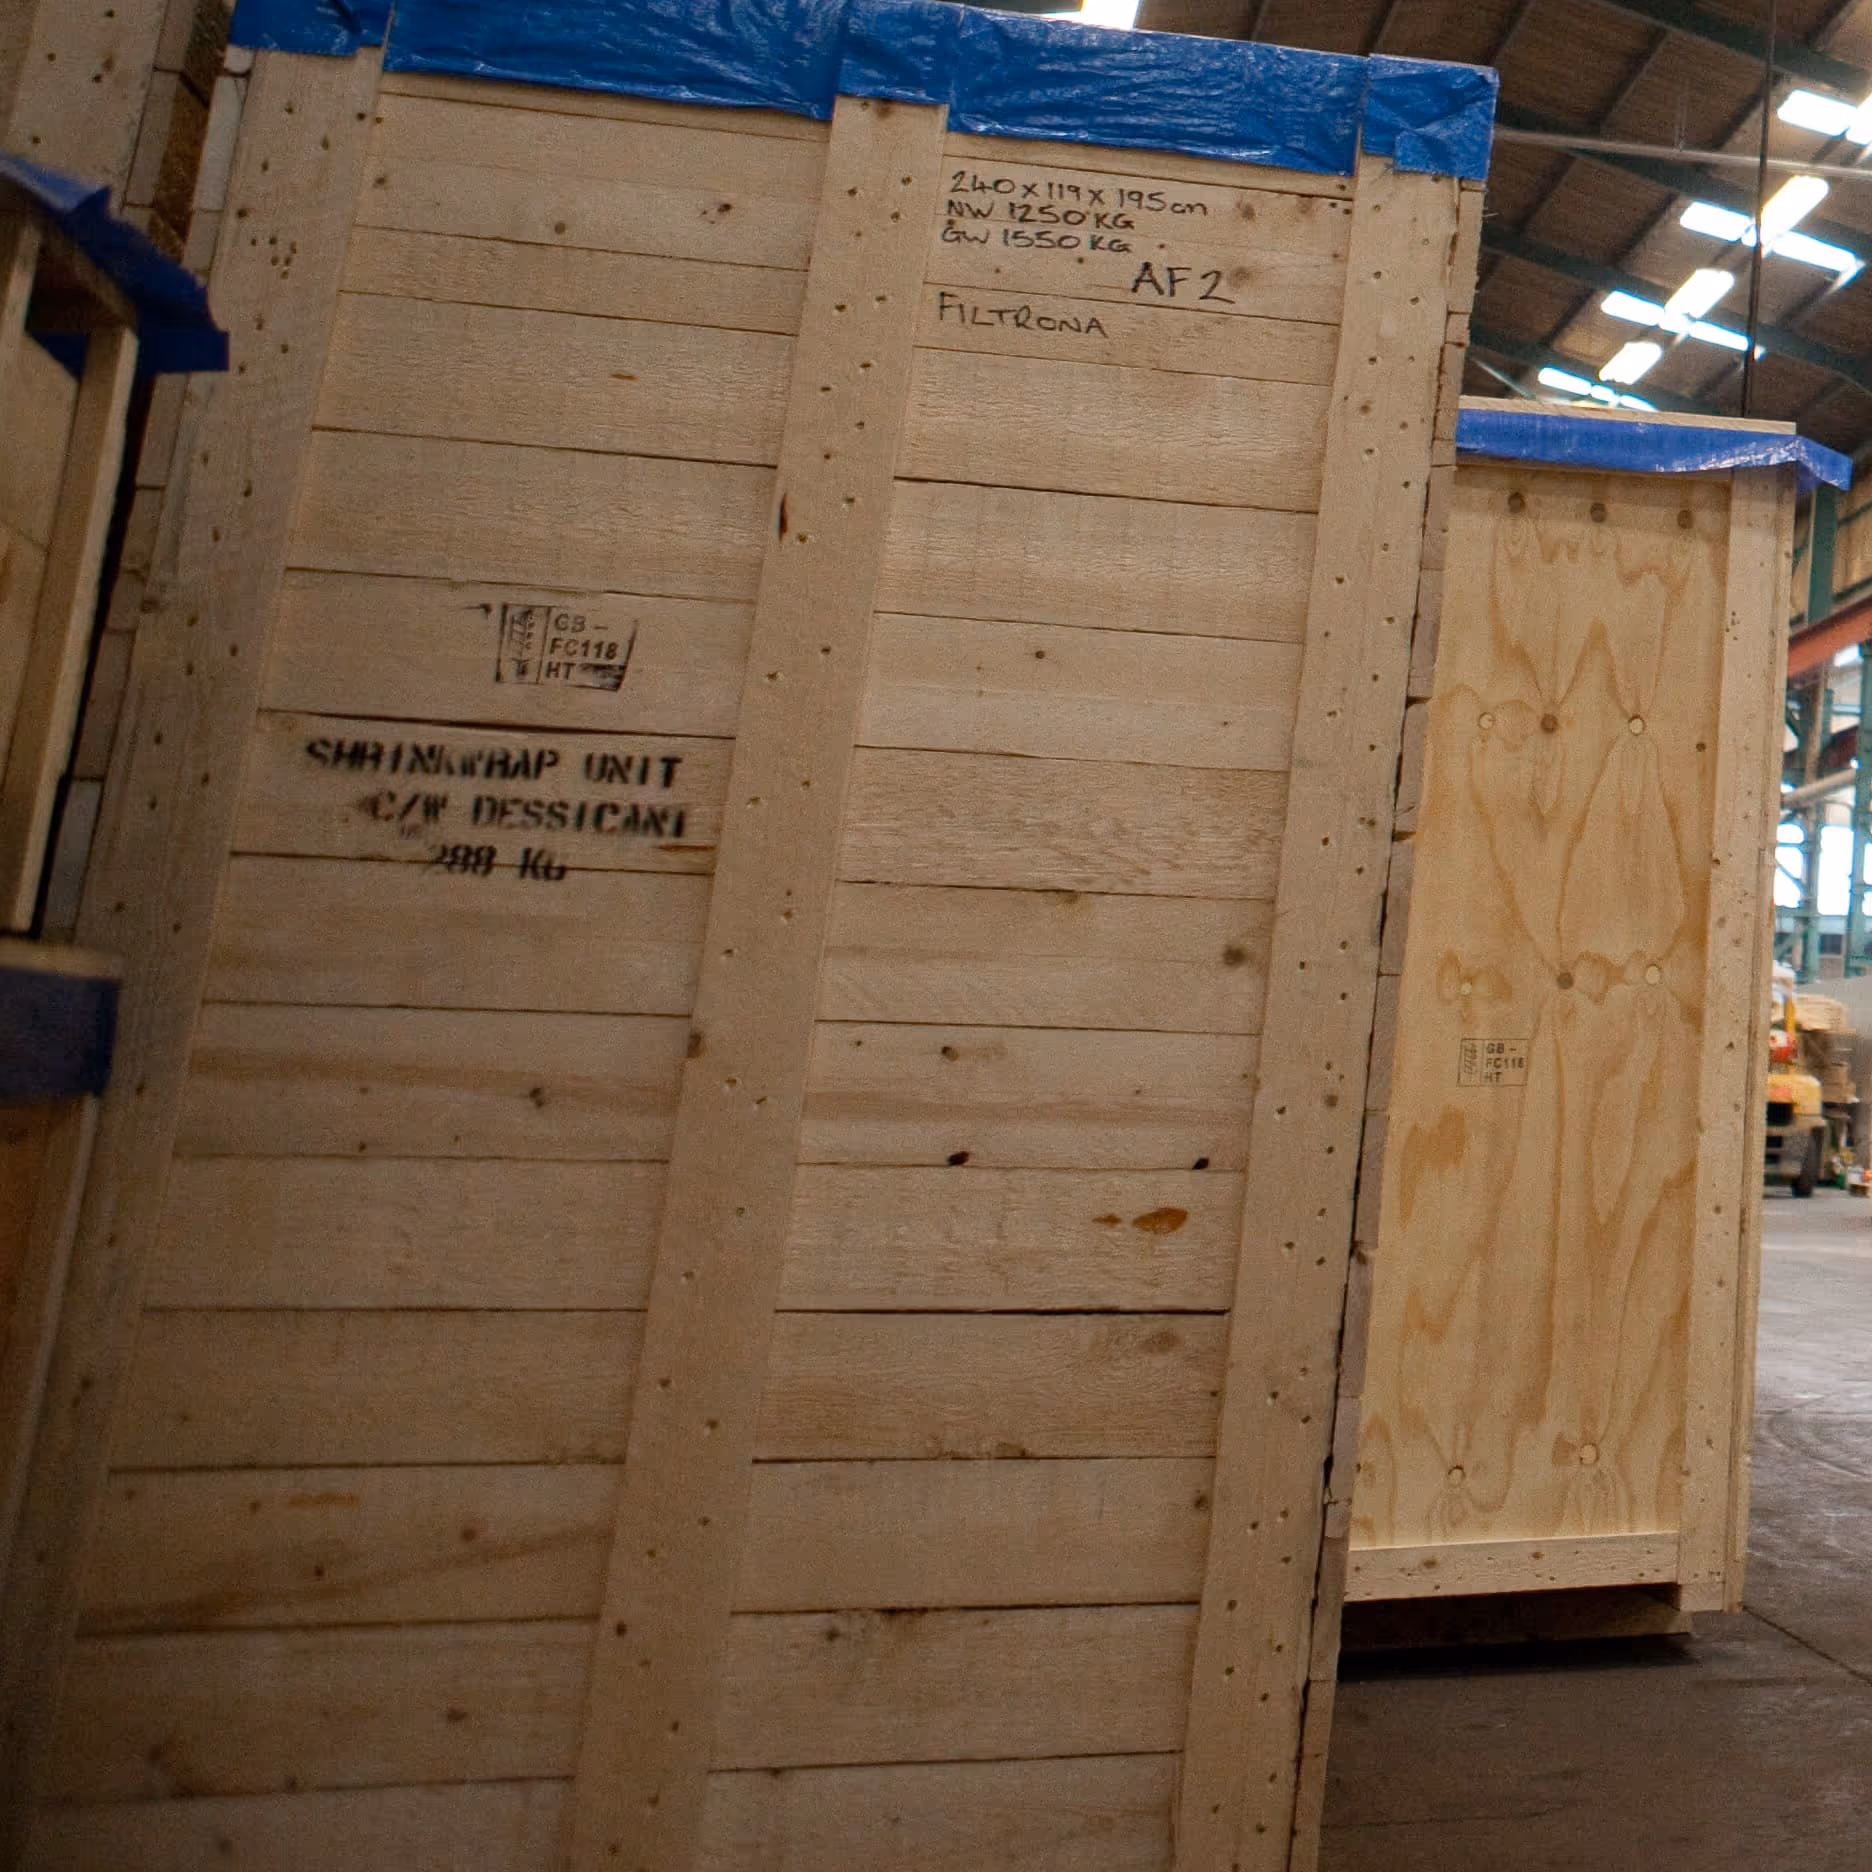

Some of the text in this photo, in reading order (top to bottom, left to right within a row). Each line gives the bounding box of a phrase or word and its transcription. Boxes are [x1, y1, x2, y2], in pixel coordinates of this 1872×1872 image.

[950, 171, 1016, 194] 240
[1047, 181, 1081, 202] 119
[947, 199, 1135, 230] NW 1250 KG
[942, 226, 1133, 253] GW 1550 KG
[939, 291, 1109, 339] FILTRONA
[555, 613, 586, 633] GB
[550, 637, 619, 660] FC118
[545, 660, 577, 680] HT
[306, 738, 683, 789] SHRINKWRAP UNIT
[1487, 1042, 1505, 1054] GB
